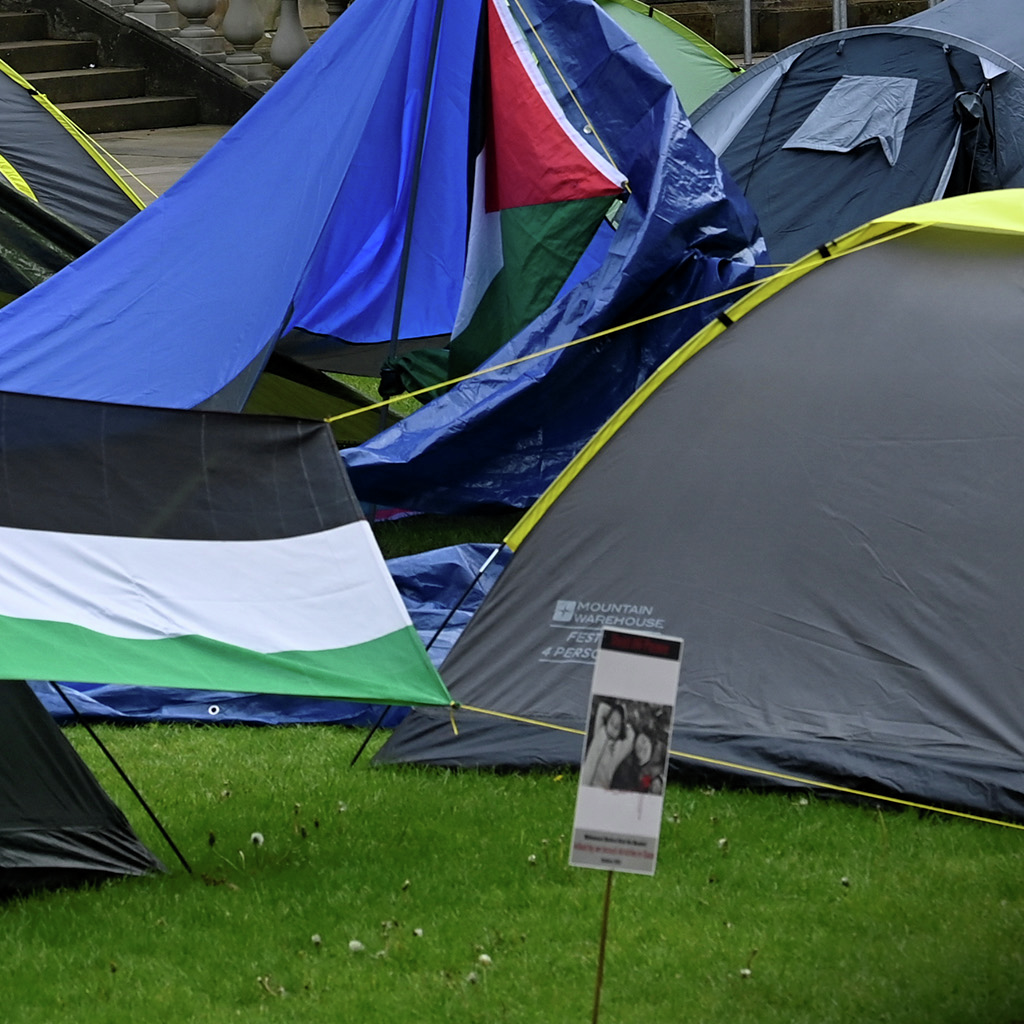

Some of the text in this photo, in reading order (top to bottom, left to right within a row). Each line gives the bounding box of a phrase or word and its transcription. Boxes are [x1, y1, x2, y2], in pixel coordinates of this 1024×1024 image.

[577, 601, 654, 616] MOUNTAIN
[574, 613, 666, 629] WAREHOUSE
[541, 647, 553, 657] 4
